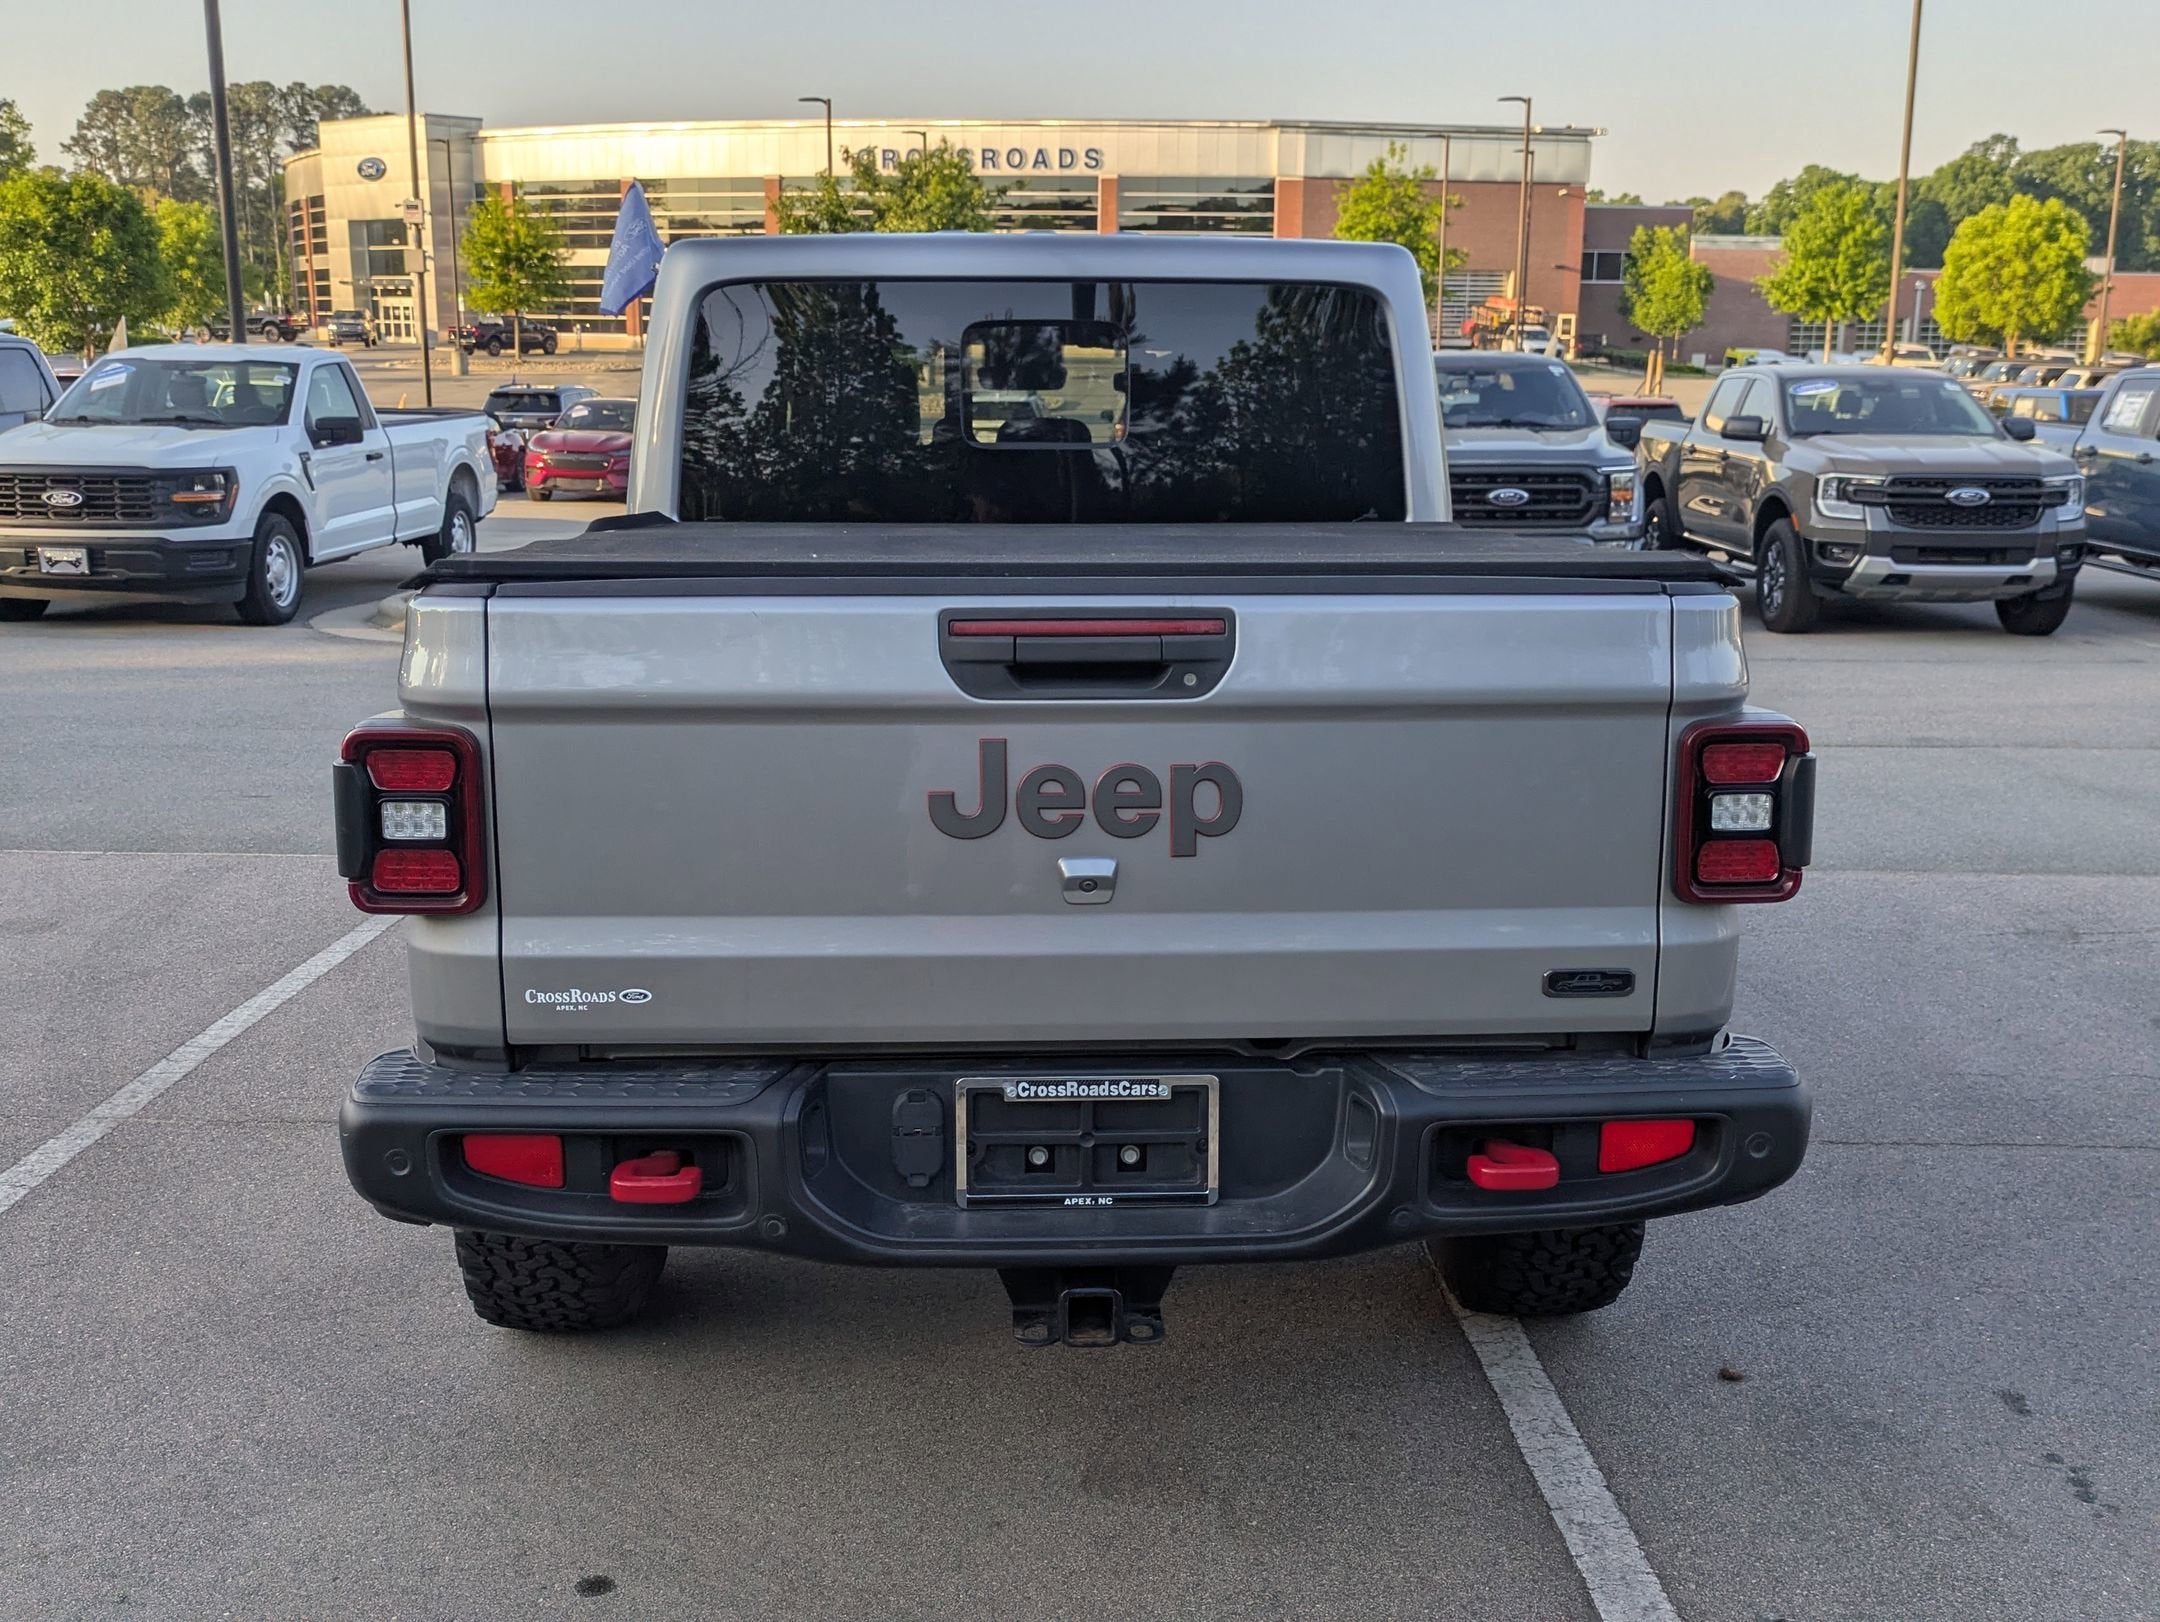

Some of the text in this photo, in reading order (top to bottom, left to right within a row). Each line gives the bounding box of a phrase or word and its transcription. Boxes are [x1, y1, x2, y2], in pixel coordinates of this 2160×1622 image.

[927, 737, 1243, 858] Jeep
[1017, 1080, 1157, 1098] CrossRoadsCars
[1063, 1197, 1113, 1206] APEX, NC
